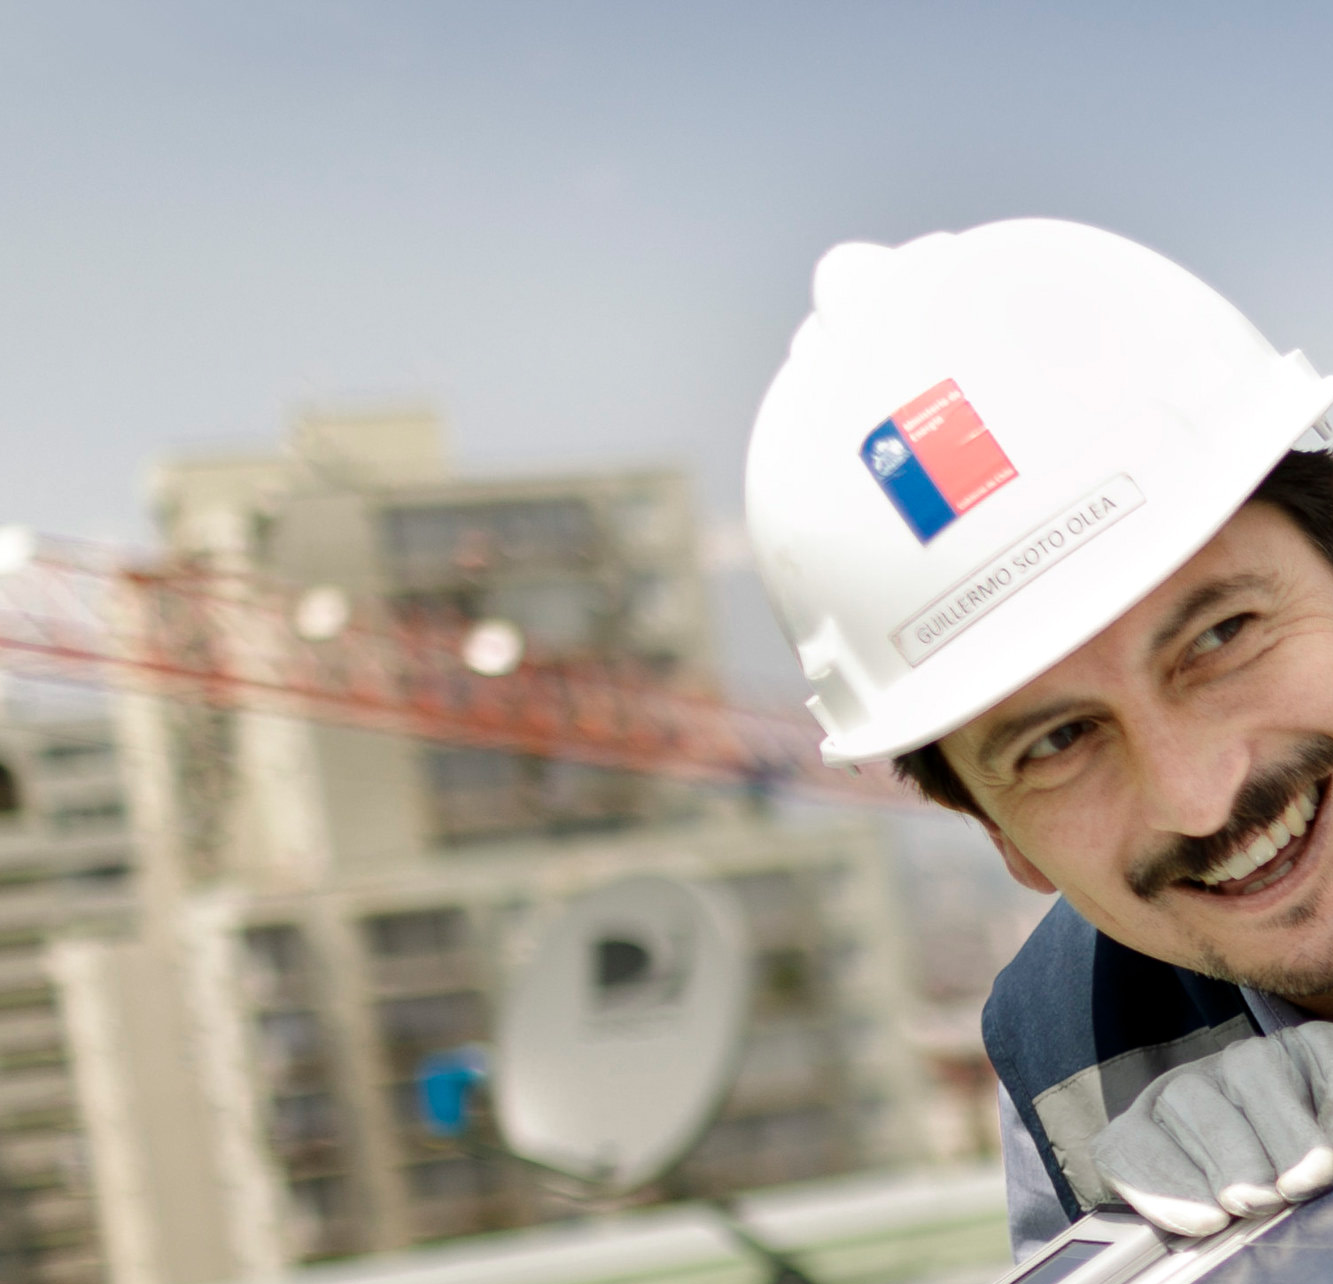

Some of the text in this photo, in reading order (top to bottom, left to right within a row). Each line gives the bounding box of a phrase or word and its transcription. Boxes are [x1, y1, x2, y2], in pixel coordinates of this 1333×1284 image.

[916, 496, 1118, 645] GUILLERMO SOTO OLEA
